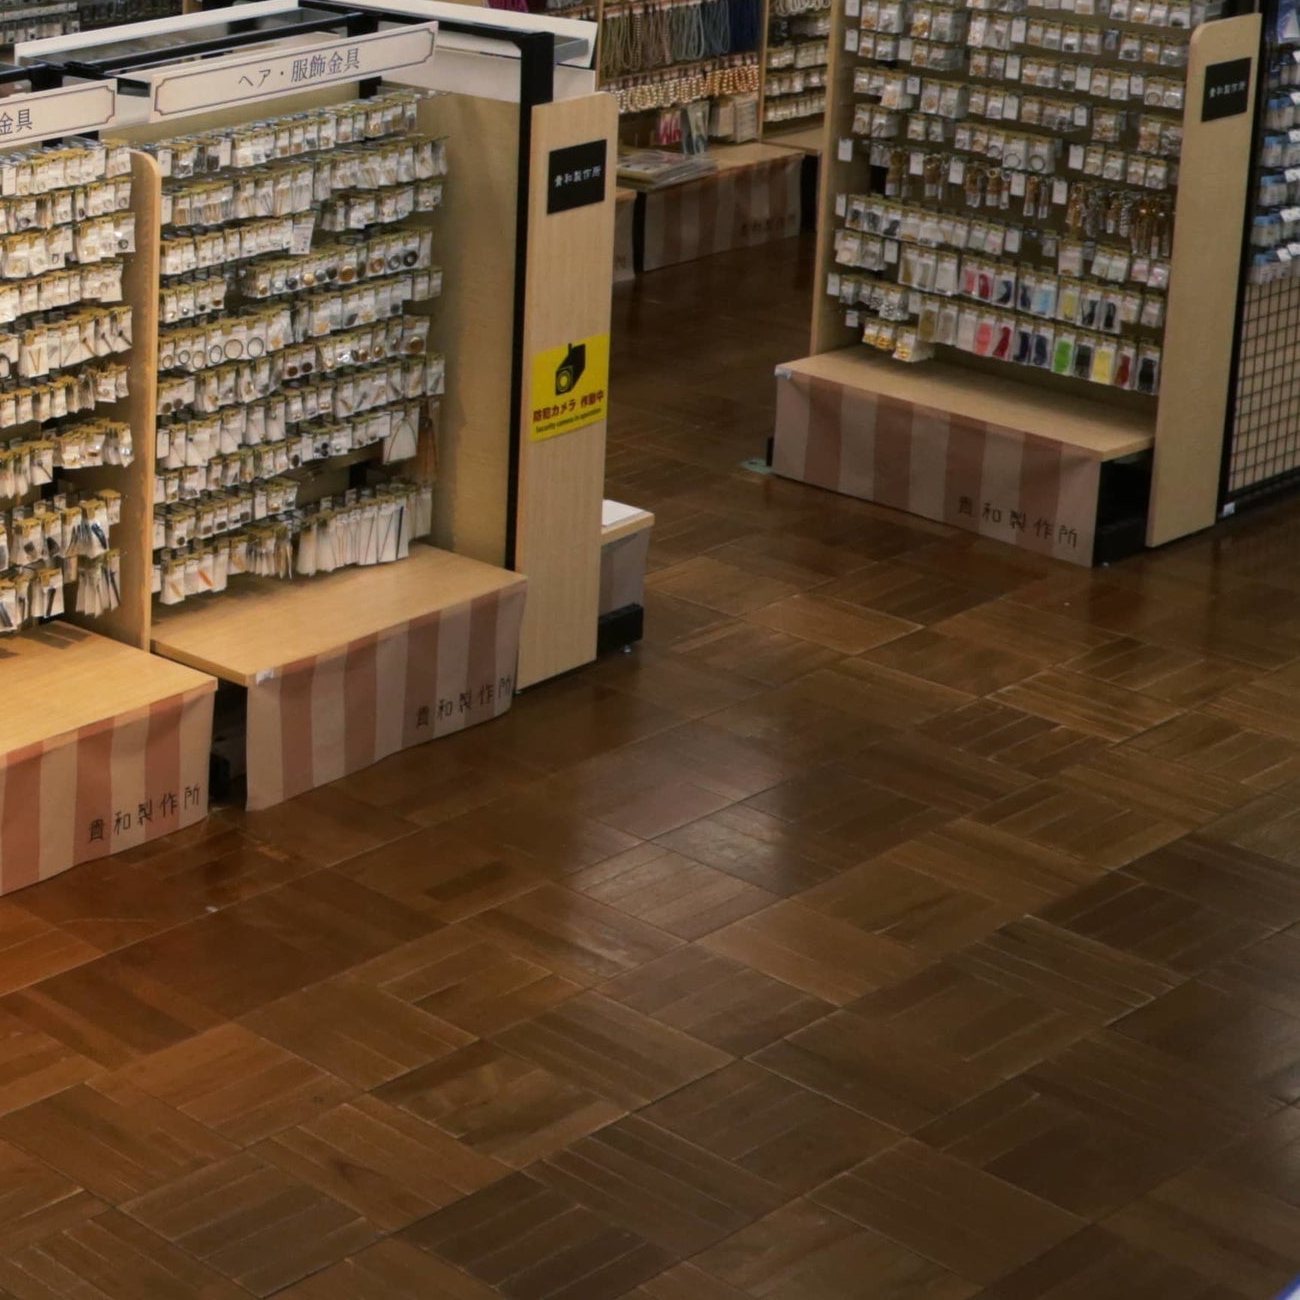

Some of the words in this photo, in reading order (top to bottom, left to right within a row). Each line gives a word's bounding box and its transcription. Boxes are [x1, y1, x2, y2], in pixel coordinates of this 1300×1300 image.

[237, 45, 363, 90] ヘア・服飾金具
[554, 165, 602, 188] 貴和製作所
[532, 398, 577, 423] 防犯カメラ
[958, 496, 1079, 550] 貴和製作所
[414, 674, 514, 730] 貴和製作所
[88, 783, 201, 845] 貴和製作所
